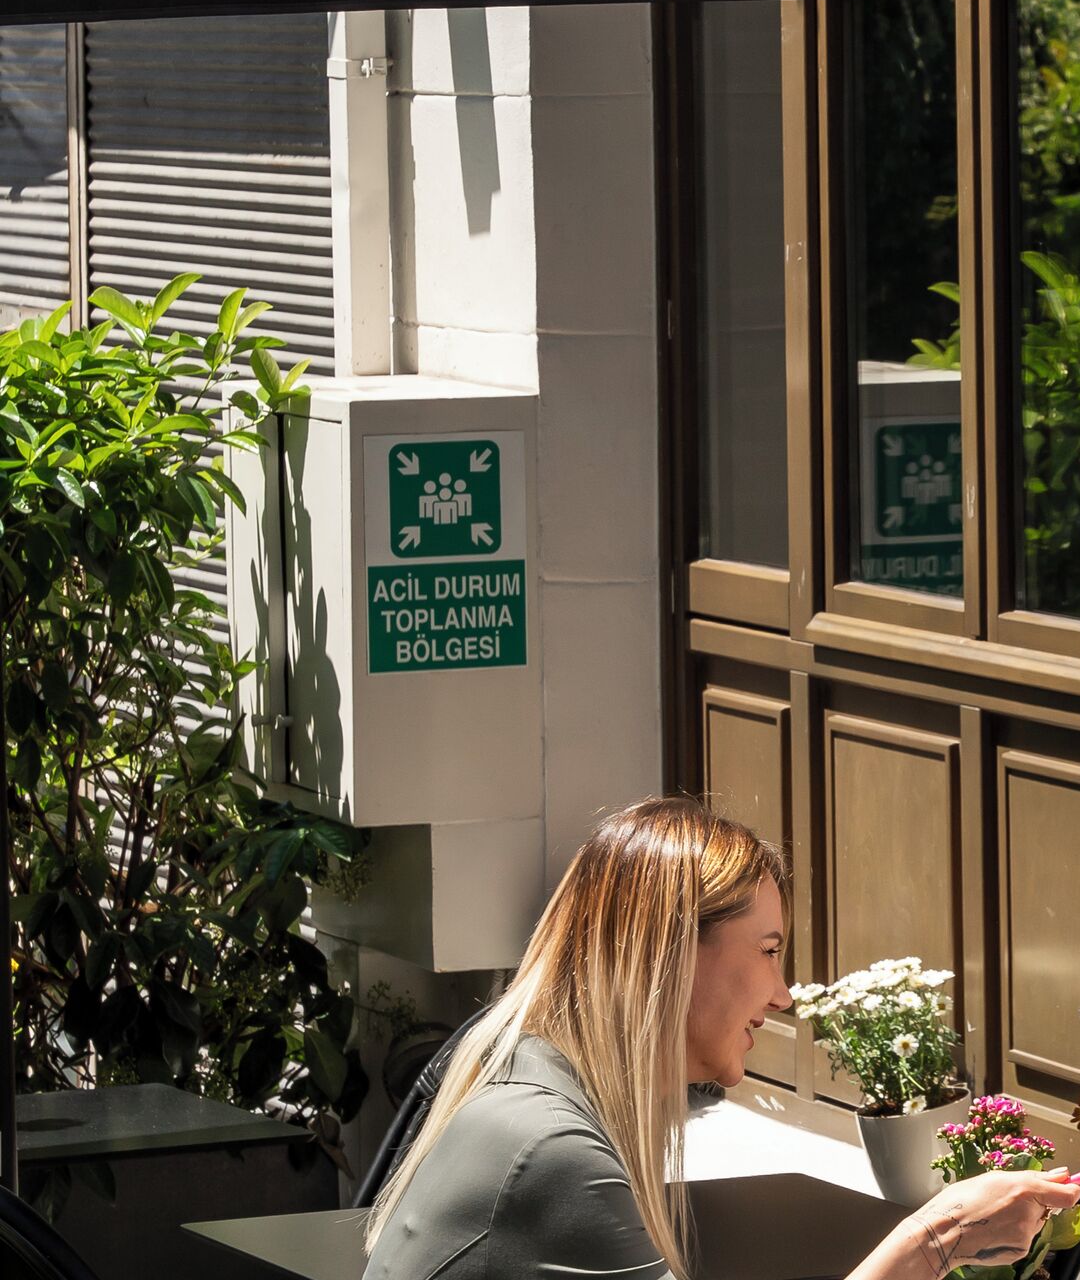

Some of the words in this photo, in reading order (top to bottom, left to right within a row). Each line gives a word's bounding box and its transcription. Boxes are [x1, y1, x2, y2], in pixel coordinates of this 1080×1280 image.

[373, 573, 428, 602] ACİL
[434, 573, 520, 600] DURUM
[381, 605, 514, 633] TOPLANMA
[396, 630, 500, 663] BÖLGESİ
